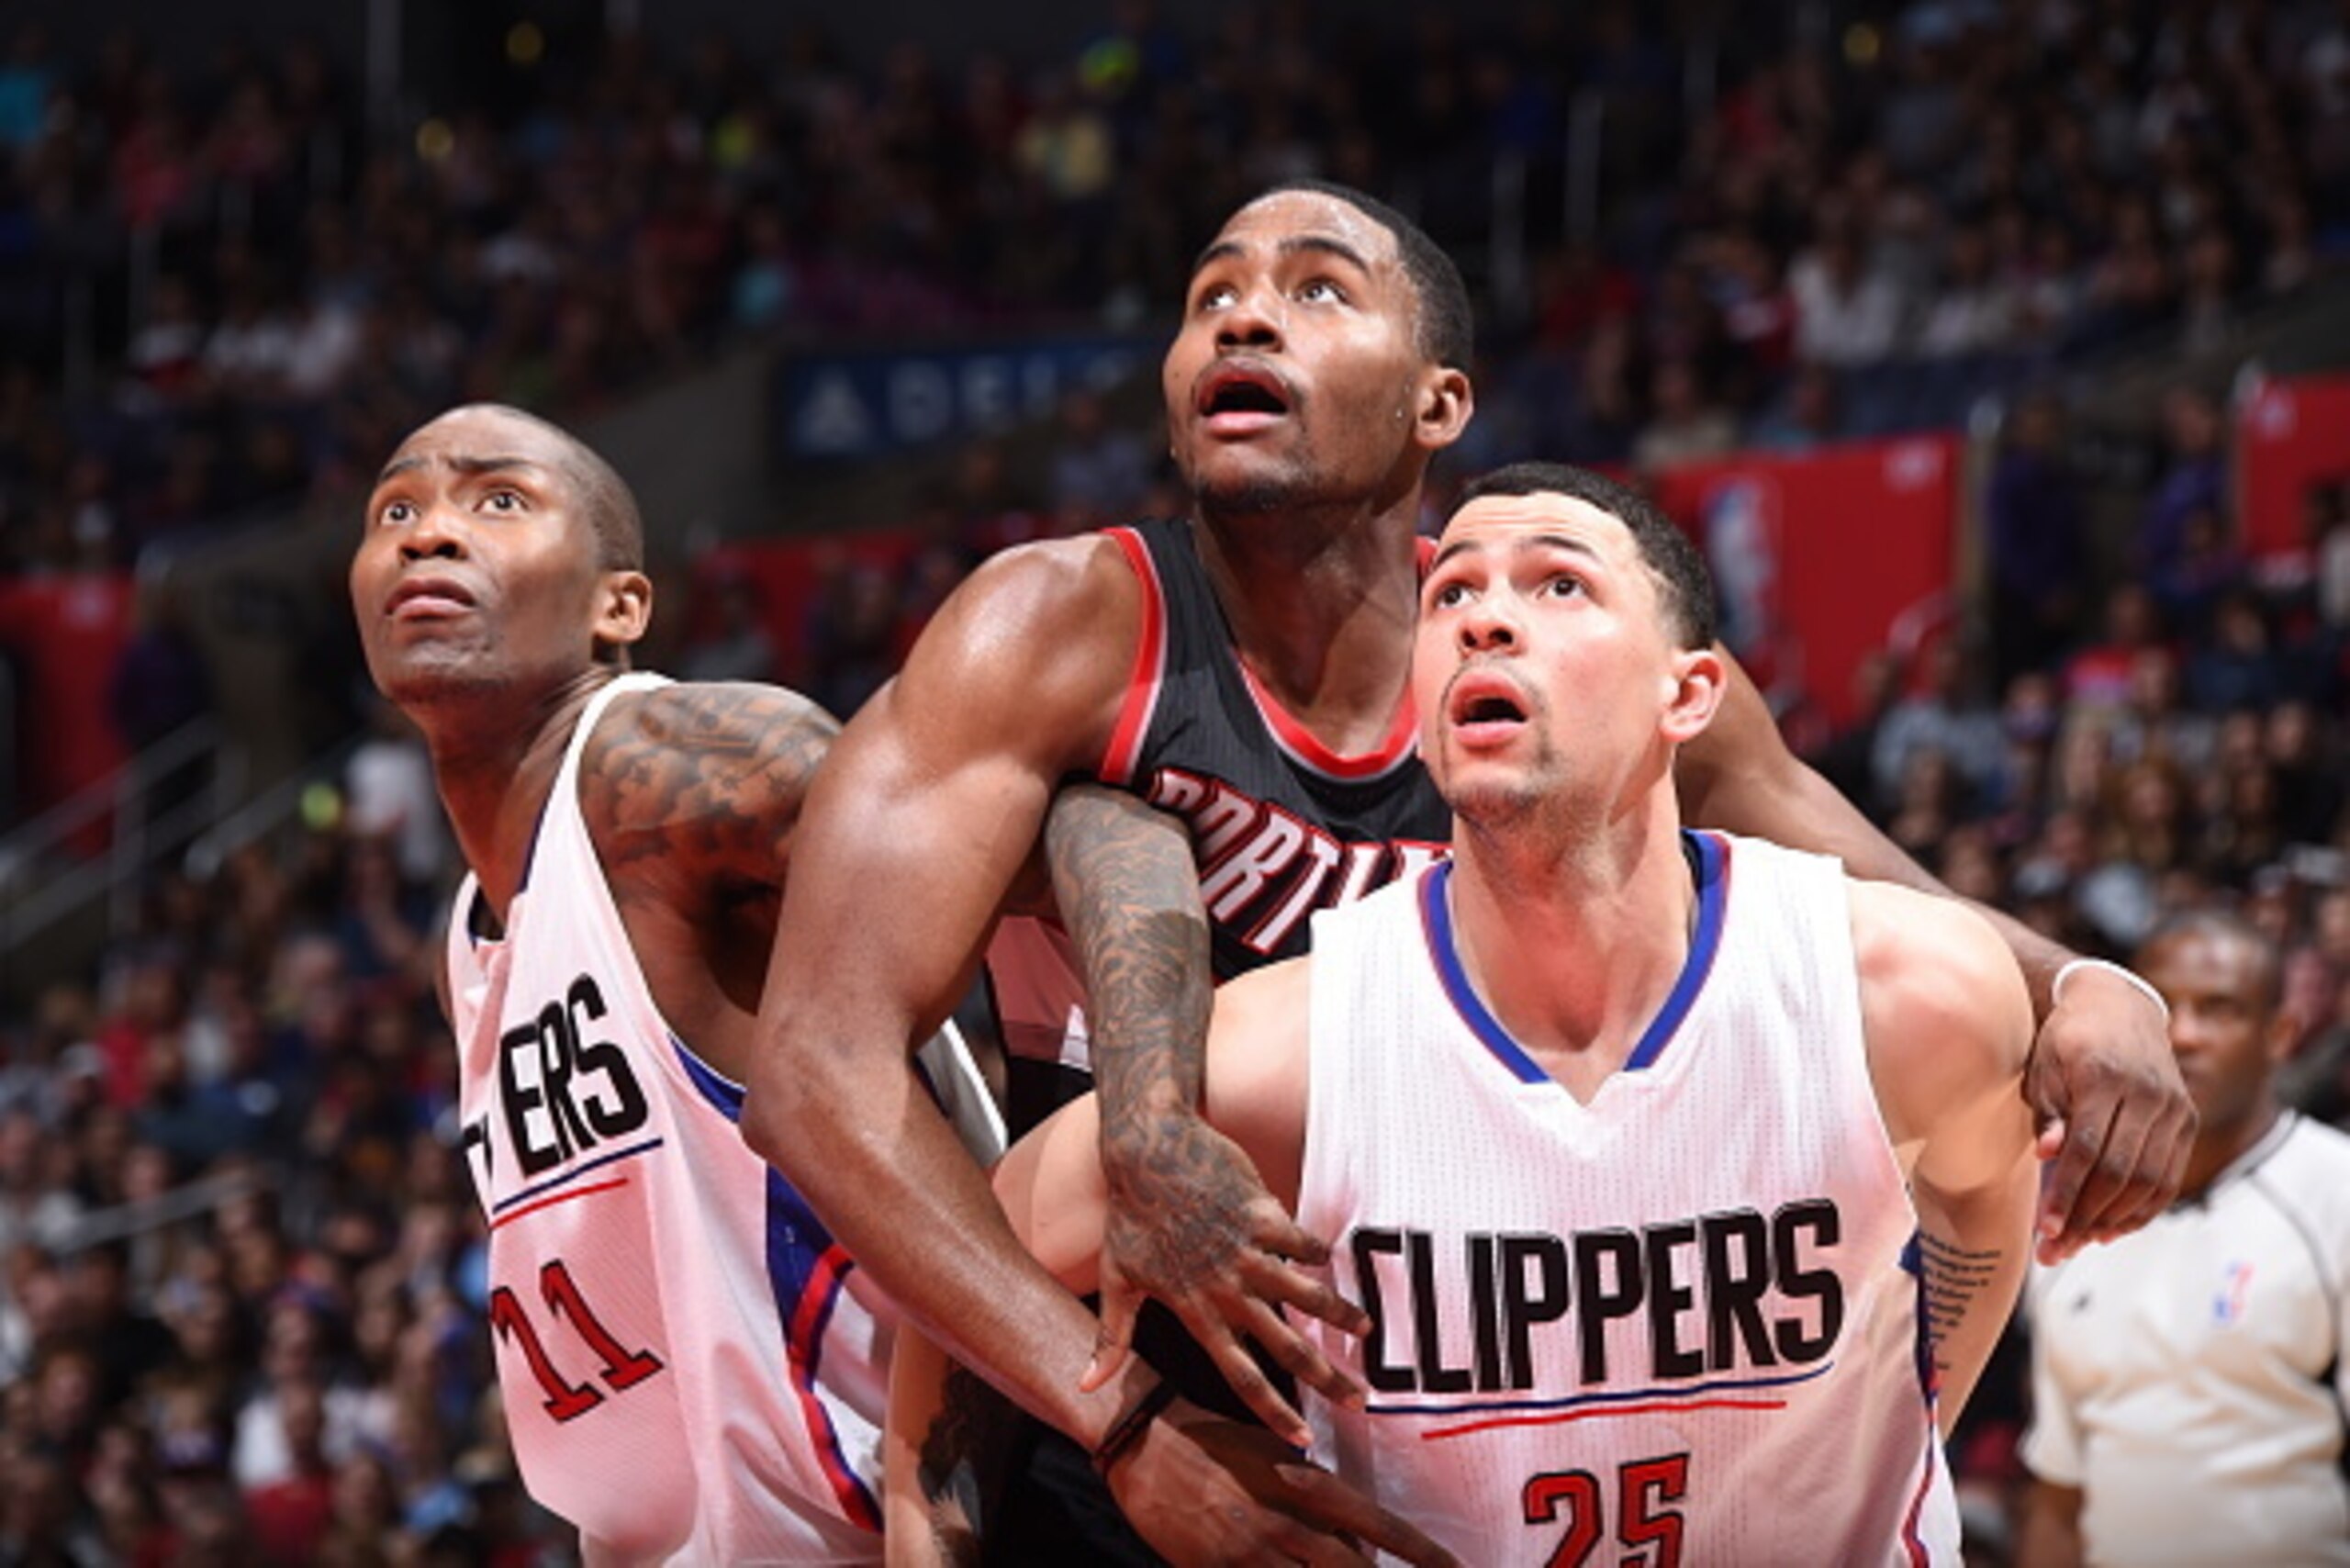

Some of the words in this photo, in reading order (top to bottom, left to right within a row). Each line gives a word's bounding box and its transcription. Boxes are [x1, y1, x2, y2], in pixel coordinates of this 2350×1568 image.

[490, 1259, 664, 1423] 11
[1350, 1199, 1843, 1394] CLIPPERS
[1522, 1452, 1692, 1568] 25
